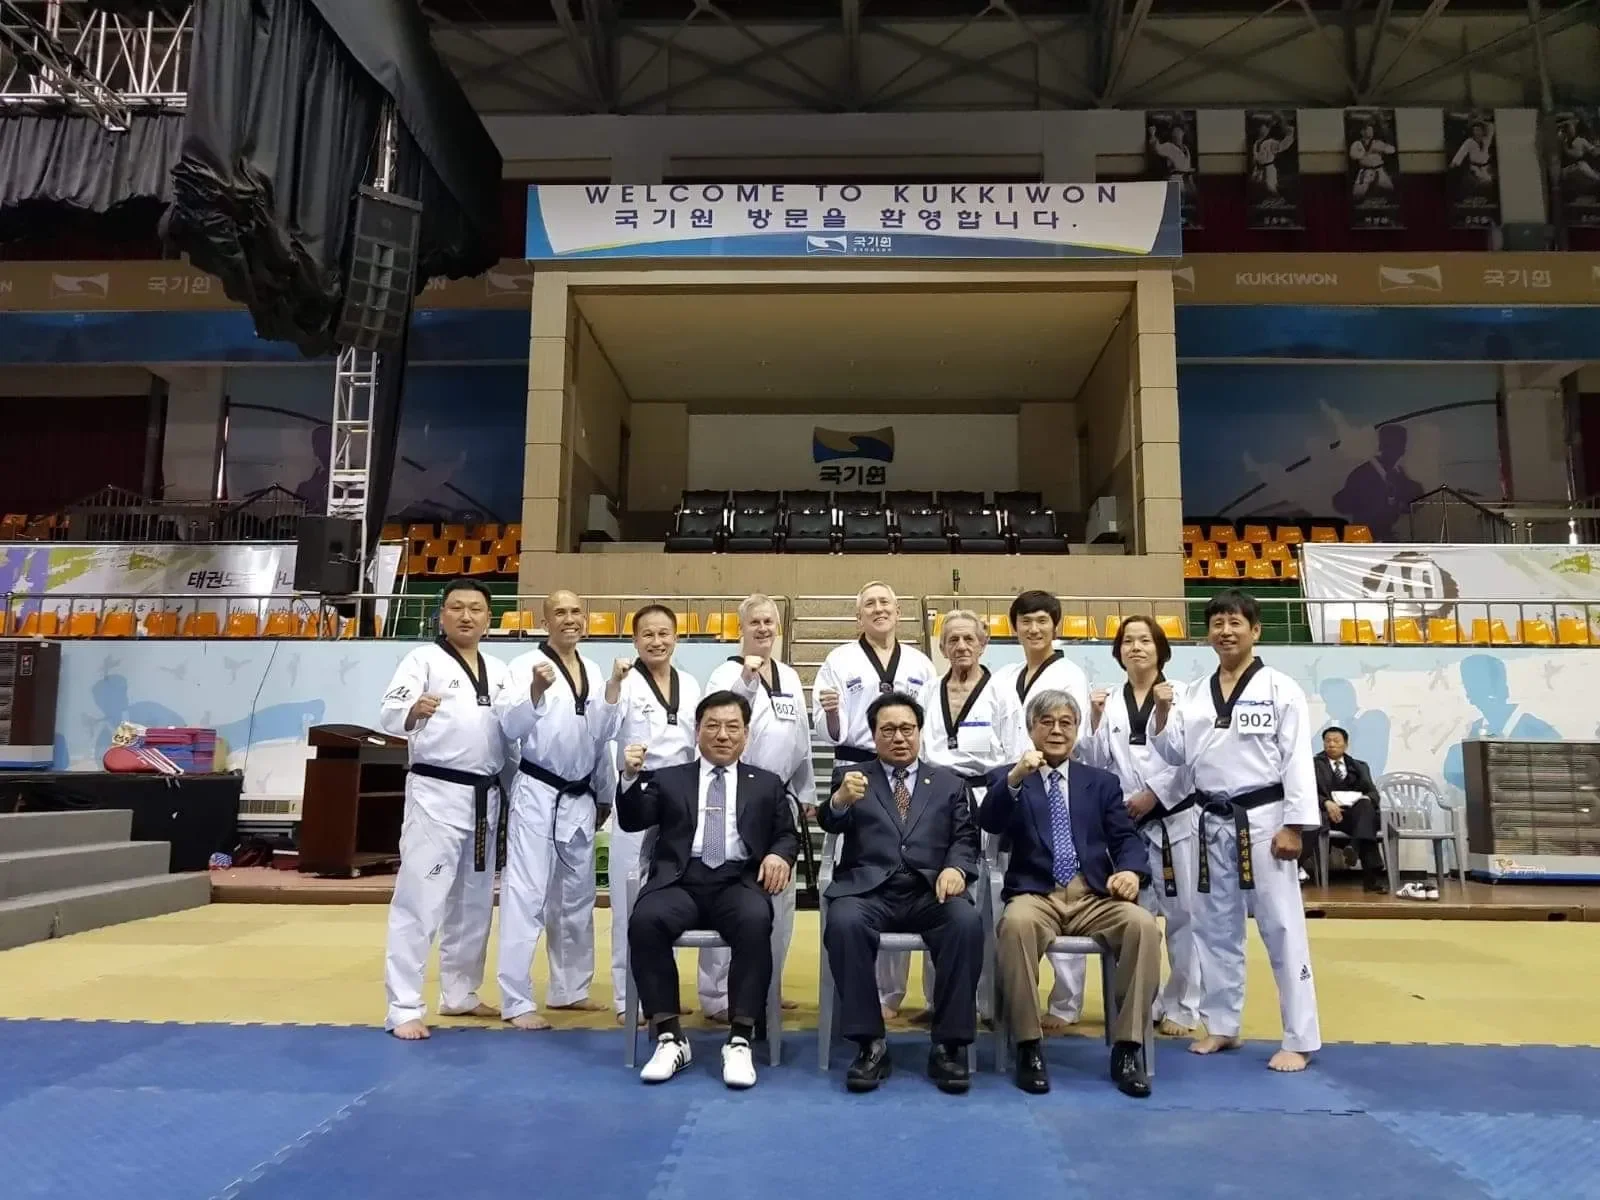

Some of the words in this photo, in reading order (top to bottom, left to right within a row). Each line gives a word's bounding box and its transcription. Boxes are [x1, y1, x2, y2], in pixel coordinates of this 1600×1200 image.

[584, 184, 784, 204] WELCOME
[815, 184, 862, 202] TO
[894, 185, 1116, 204] KUKKIWON
[614, 208, 714, 229] 국기원
[747, 207, 846, 229] 방문을
[879, 207, 1078, 231] 환영합니다.
[853, 236, 892, 247] 국기원
[147, 275, 211, 295] 국기원
[1235, 271, 1338, 286] KUKKIWON
[1484, 269, 1552, 288] 국기원
[818, 464, 887, 486] 국기원
[775, 703, 796, 716] 802
[1239, 712, 1273, 728] 902
